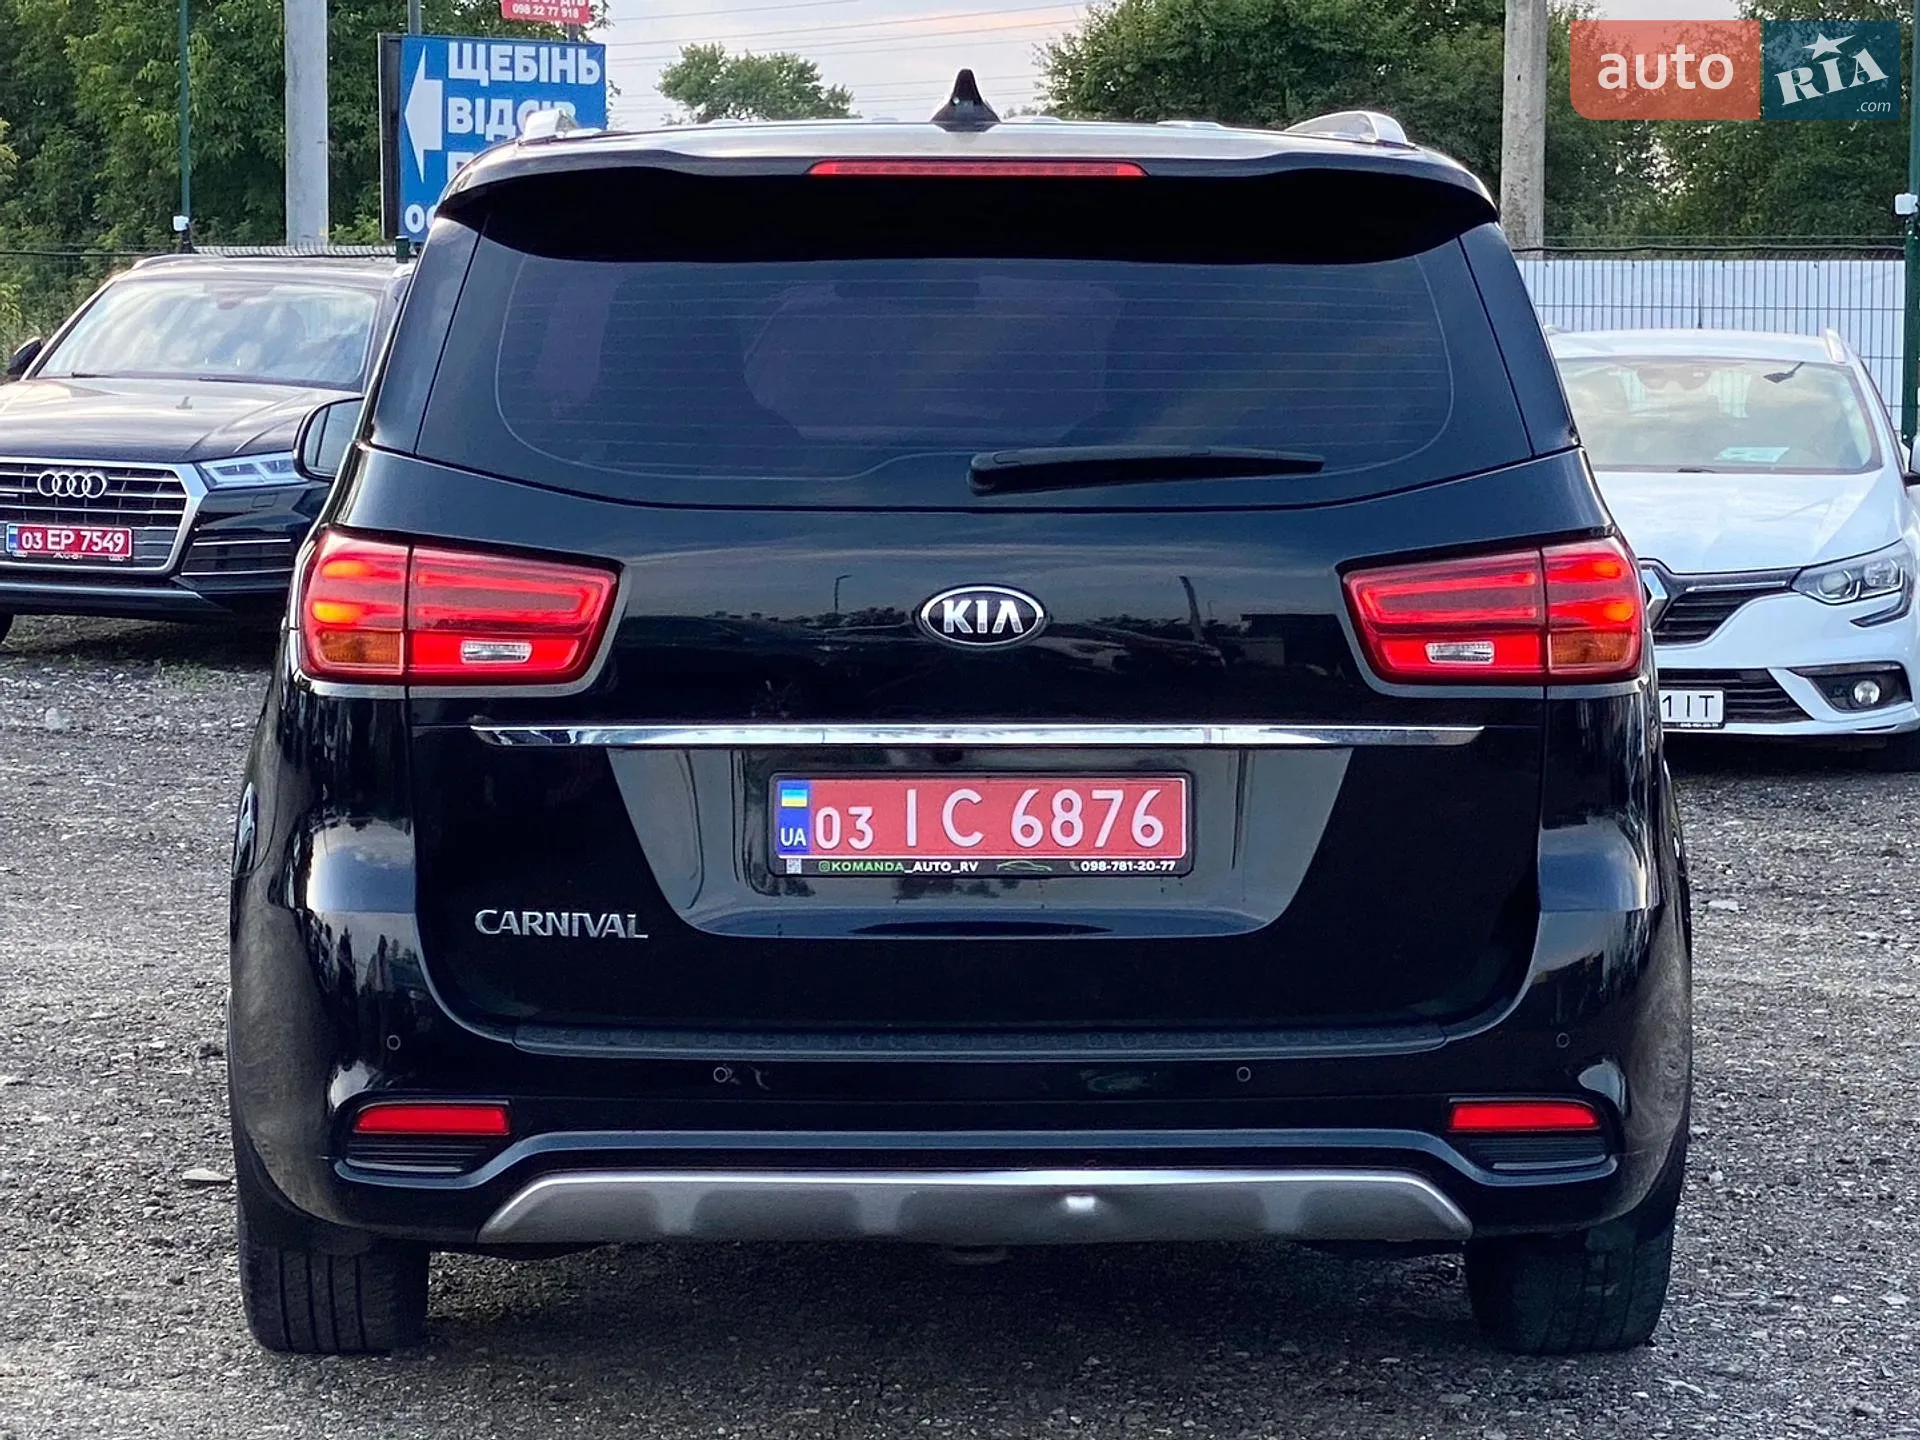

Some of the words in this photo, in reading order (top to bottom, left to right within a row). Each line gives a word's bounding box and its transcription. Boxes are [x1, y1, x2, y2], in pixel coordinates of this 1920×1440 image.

[512, 3, 530, 14] 098
[533, 6, 545, 15] 22
[547, 7, 559, 17] 77
[448, 42, 600, 87] ЩЕБІНЬ
[21, 532, 43, 549] 03
[80, 531, 125, 552] 7549
[942, 599, 1024, 634] KIA
[815, 806, 873, 850] 03
[1010, 788, 1164, 847] 6876
[780, 827, 807, 847] UA
[1080, 859, 1176, 872] 098-781-20-77
[474, 909, 649, 939] CARNIVAL
